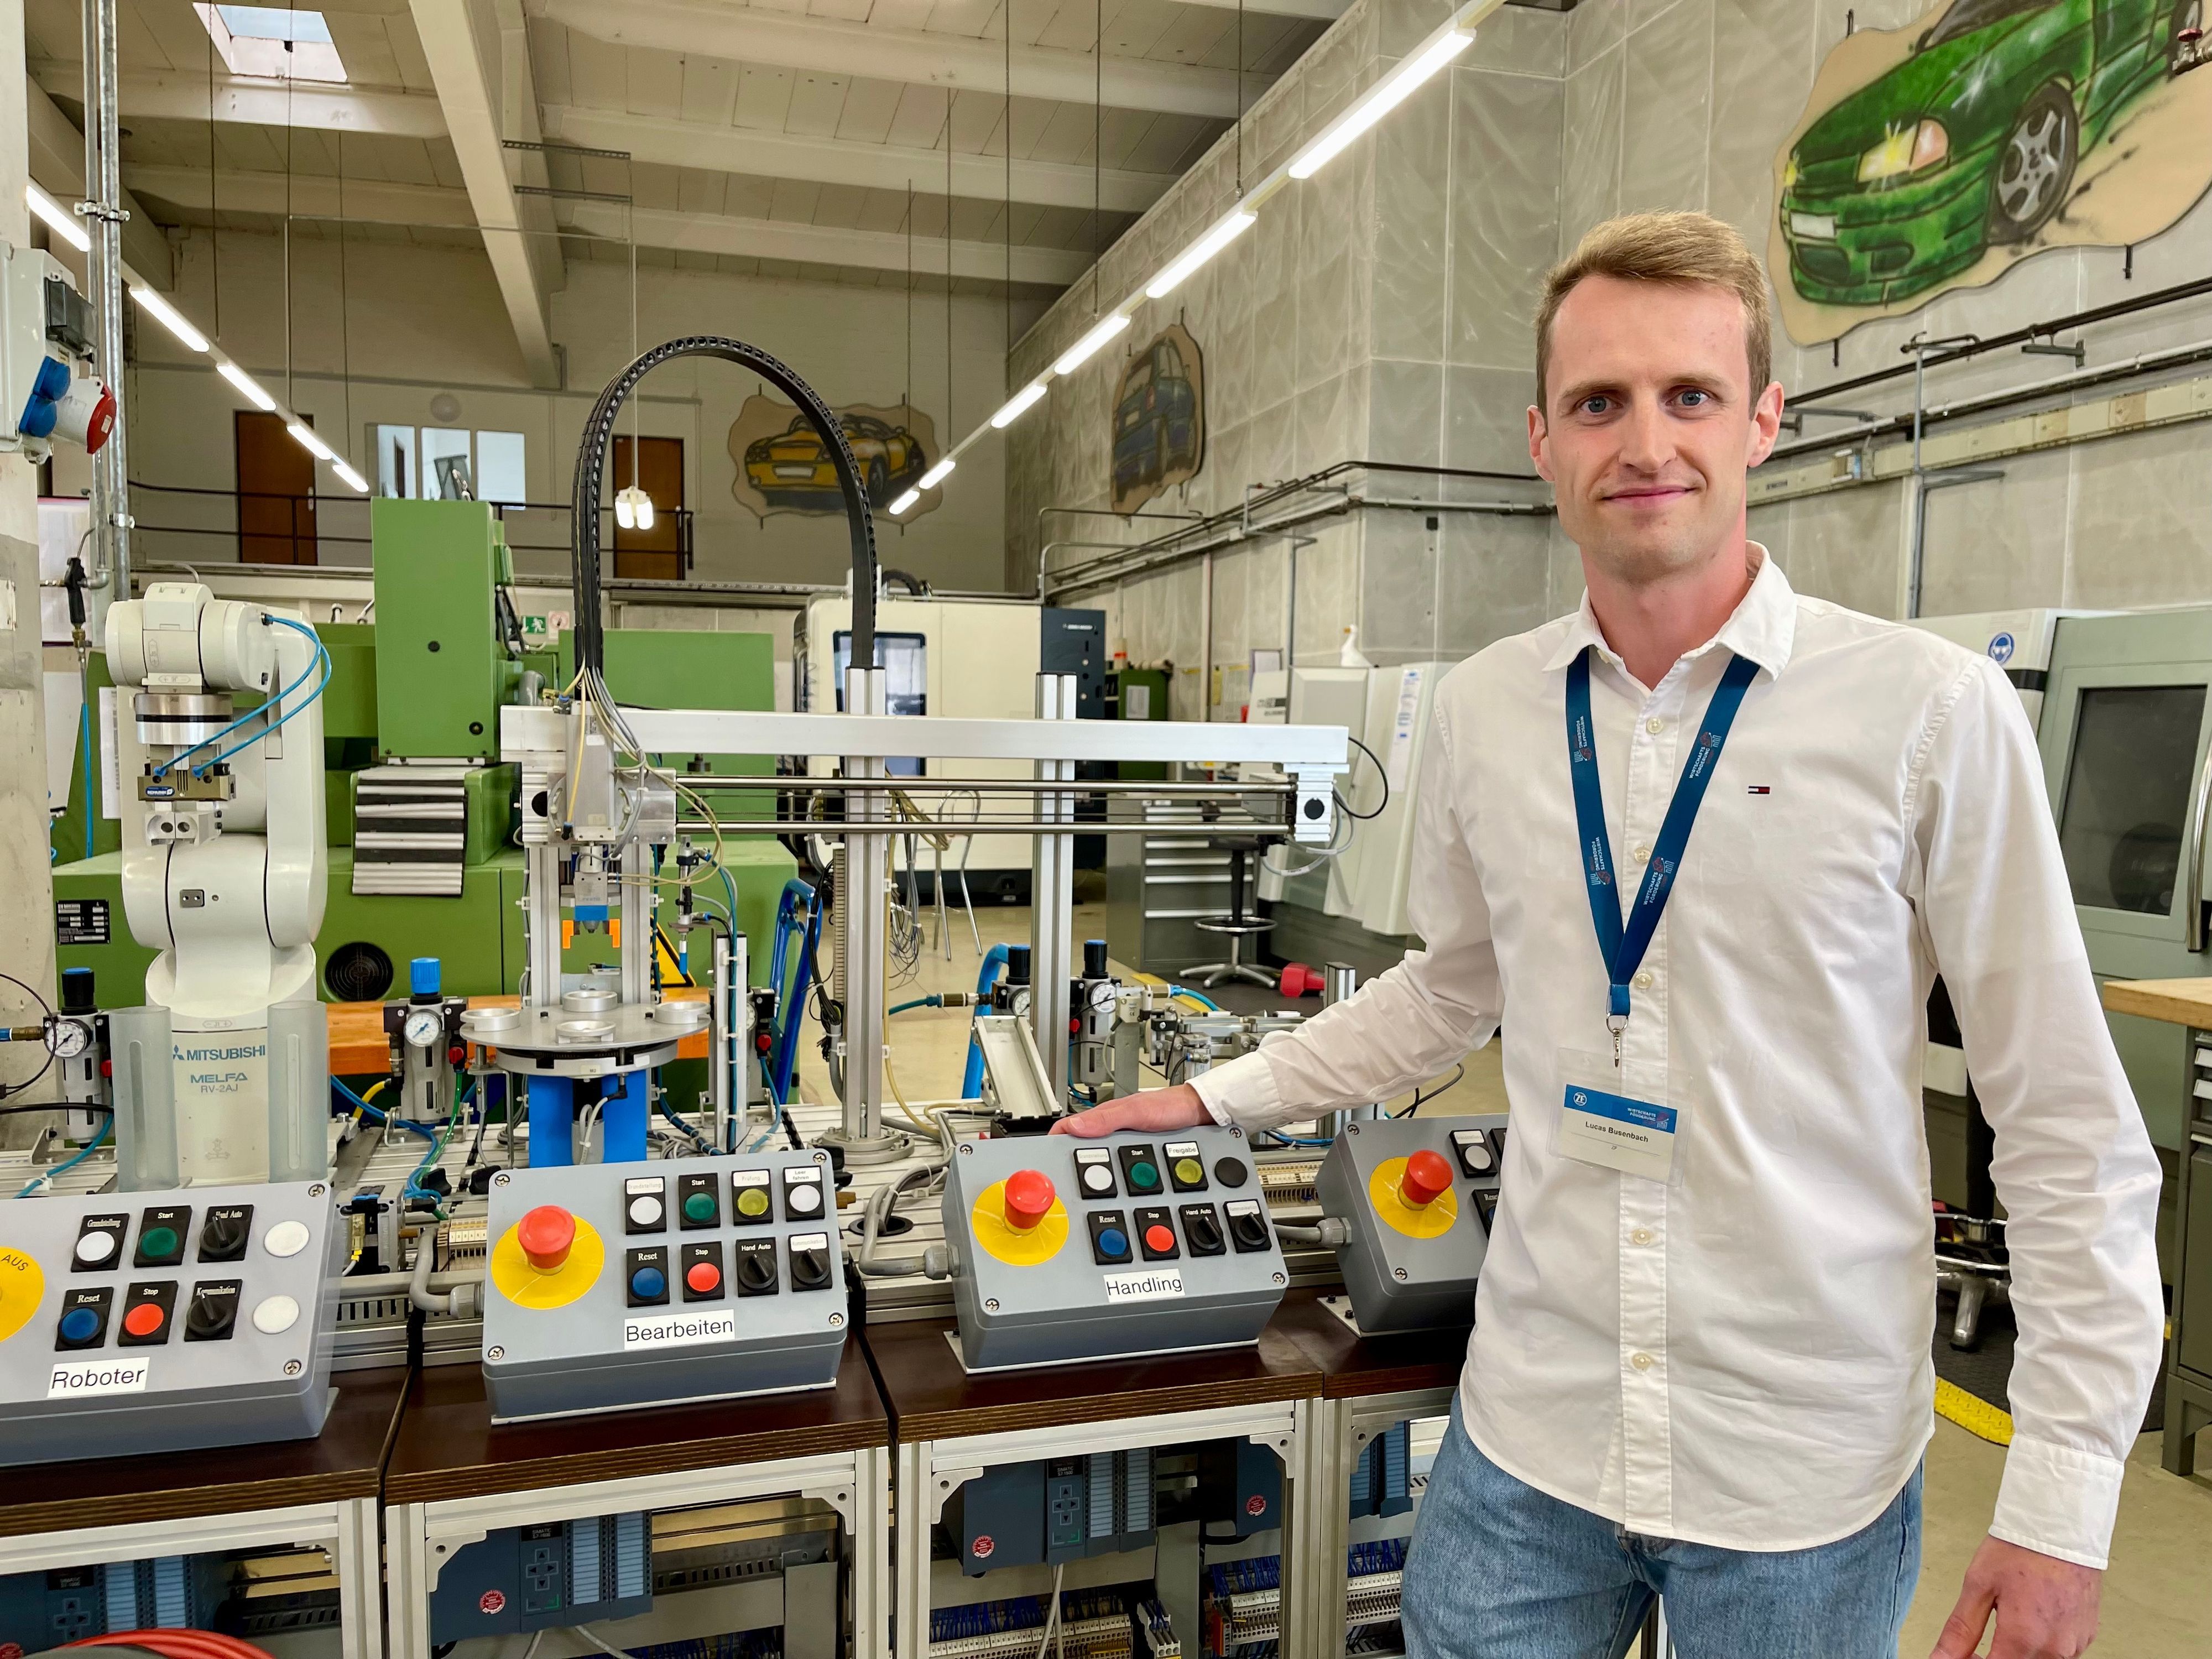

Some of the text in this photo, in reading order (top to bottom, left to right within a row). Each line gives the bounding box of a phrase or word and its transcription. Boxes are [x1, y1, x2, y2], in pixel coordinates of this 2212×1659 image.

[186, 1045, 265, 1061] MITSUBISHI
[190, 1072, 248, 1083] MELFA
[201, 1084, 238, 1093] RV-2AJ
[1585, 1121, 1648, 1142] Lucas Busenbach
[638, 1253, 658, 1261] Reset
[143, 1288, 159, 1296] Stop
[1107, 1277, 1182, 1296] Handling
[76, 1294, 101, 1304] Reset
[626, 1319, 733, 1342] Bearbeiten
[51, 1368, 145, 1389] Roboter
